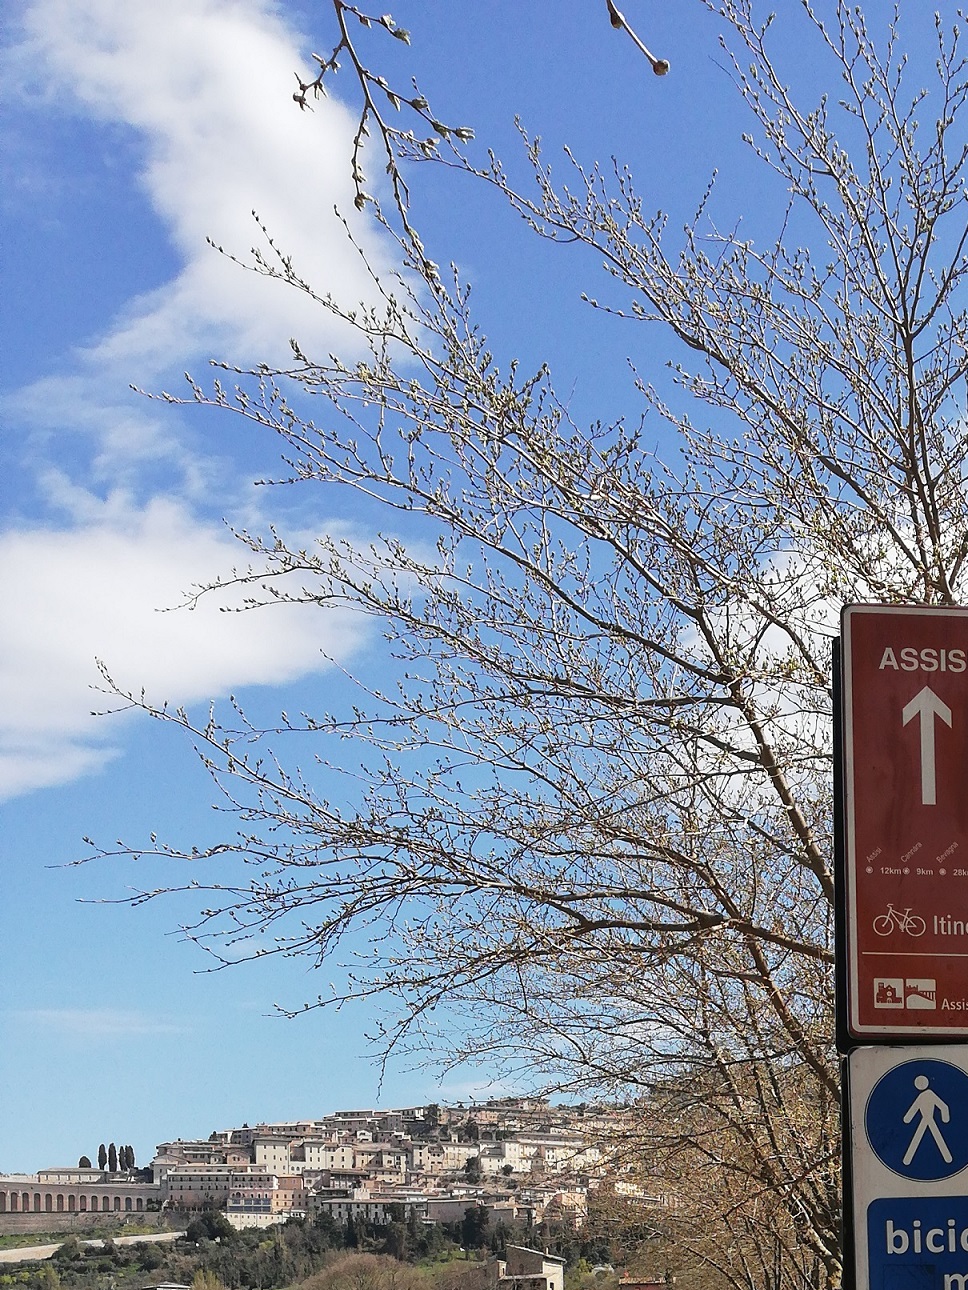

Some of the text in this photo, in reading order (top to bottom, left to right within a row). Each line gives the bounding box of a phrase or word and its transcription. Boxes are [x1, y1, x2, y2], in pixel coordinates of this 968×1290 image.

[866, 847, 882, 863] Assisi
[900, 842, 923, 863] Cannara
[935, 841, 959, 863] Bevagna
[880, 867, 902, 875] 12km
[916, 867, 934, 876] 9km
